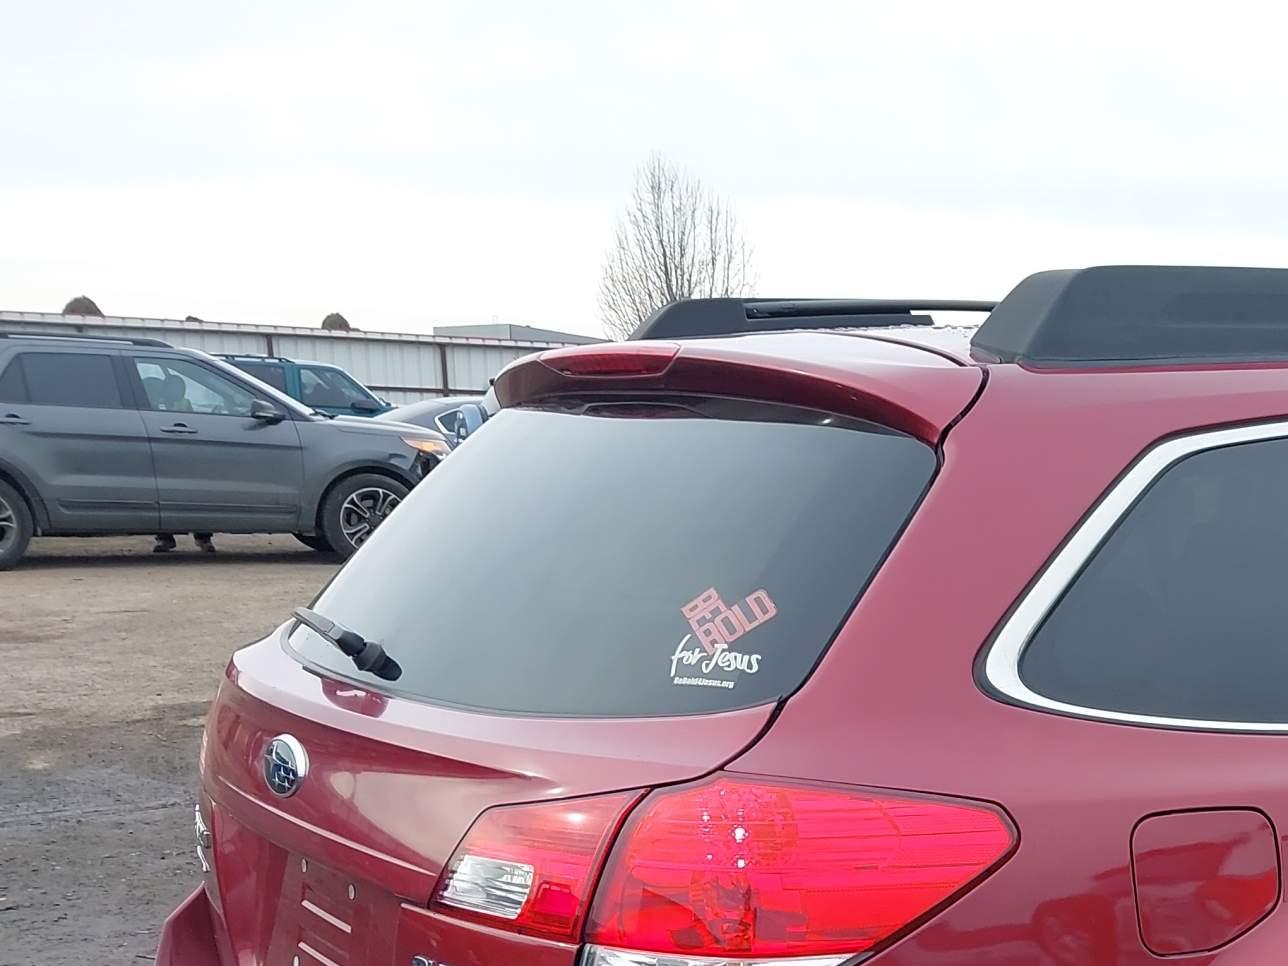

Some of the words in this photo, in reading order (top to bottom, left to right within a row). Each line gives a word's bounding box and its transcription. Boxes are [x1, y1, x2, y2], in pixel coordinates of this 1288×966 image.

[680, 586, 727, 632] BE
[699, 588, 777, 656] BOLD
[670, 633, 708, 678] for
[701, 643, 762, 674] Jesus
